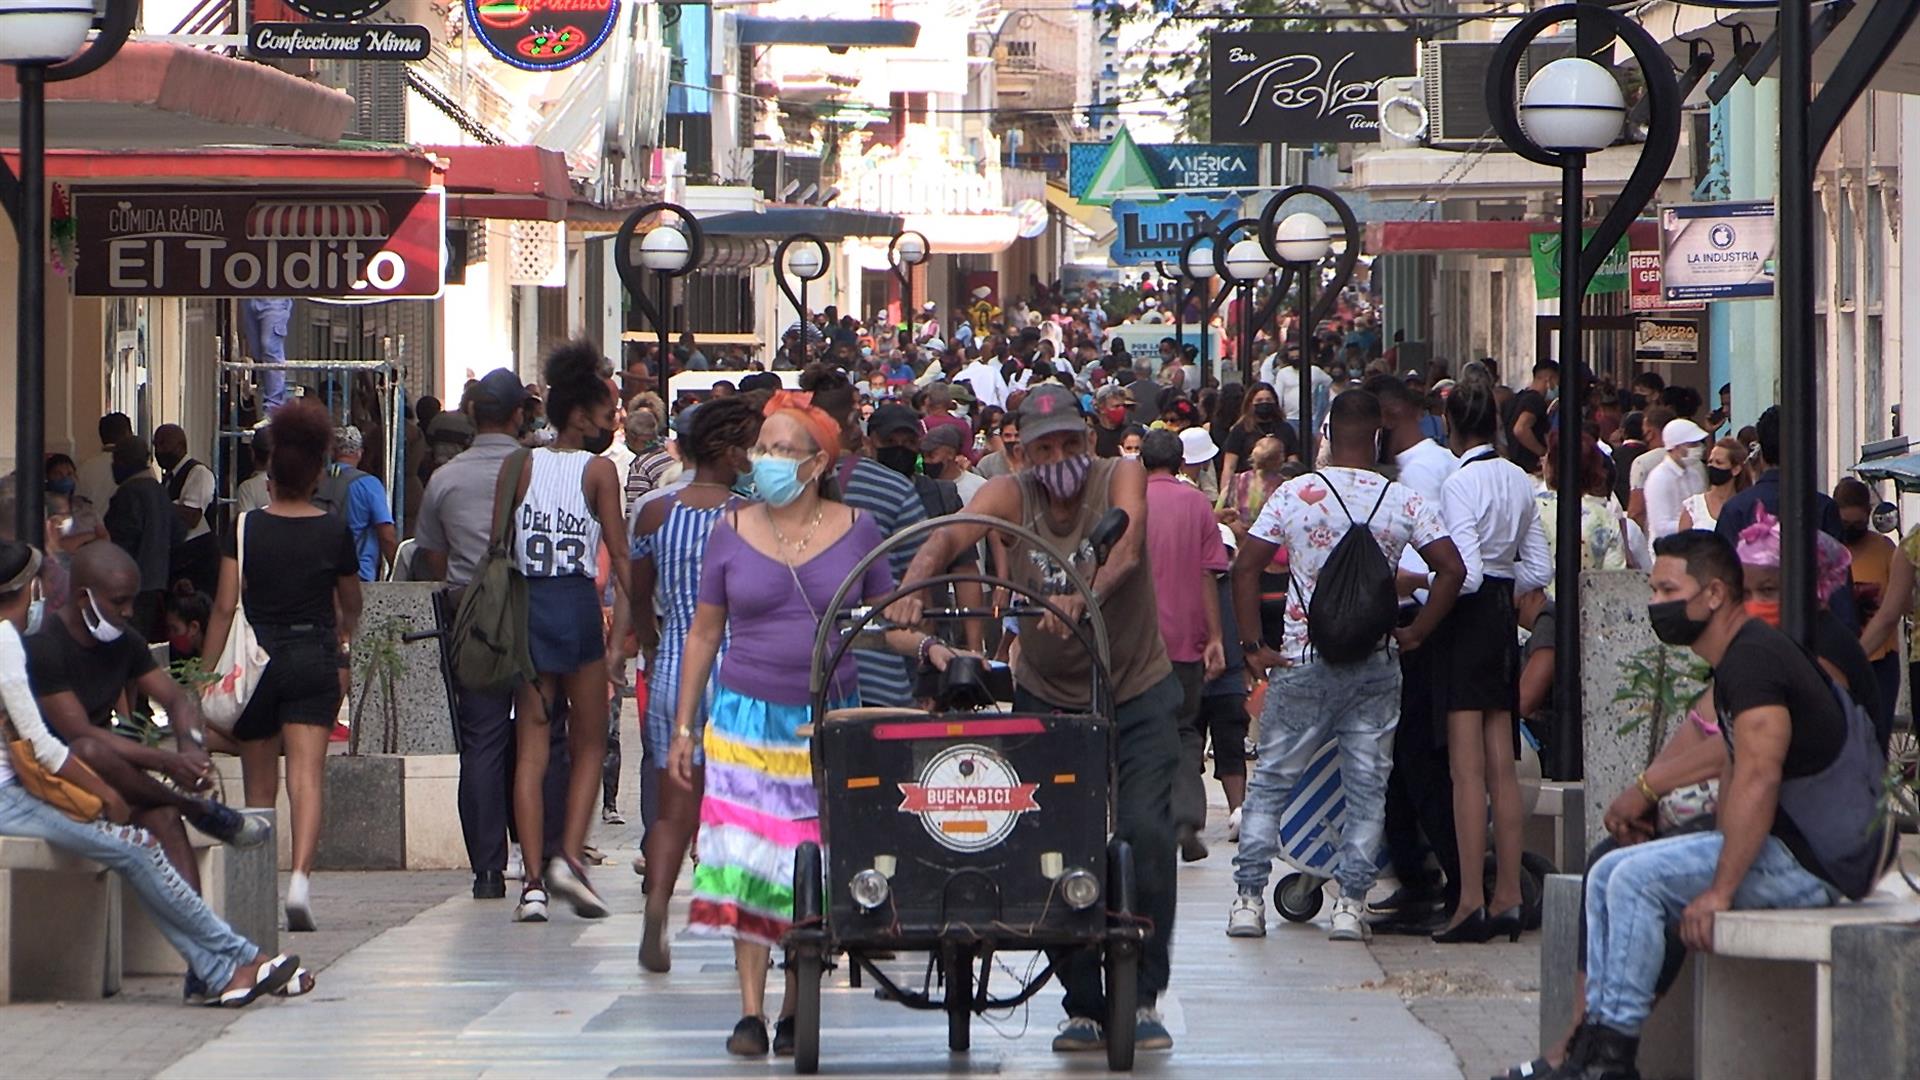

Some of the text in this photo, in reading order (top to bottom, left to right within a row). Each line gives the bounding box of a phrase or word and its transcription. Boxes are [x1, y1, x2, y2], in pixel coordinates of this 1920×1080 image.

[256, 29, 422, 54] Confecciones Mima
[1229, 48, 1257, 62] Bar
[1168, 152, 1247, 172] AMÉRICA
[1175, 172, 1219, 187] LIBRE
[109, 205, 225, 232] COMIDA RÁPIDA
[109, 239, 406, 290] El Toldito
[1687, 251, 1759, 263] LA INDUSTRIA
[526, 534, 585, 577] 93
[927, 789, 1010, 804] BUENABICI
